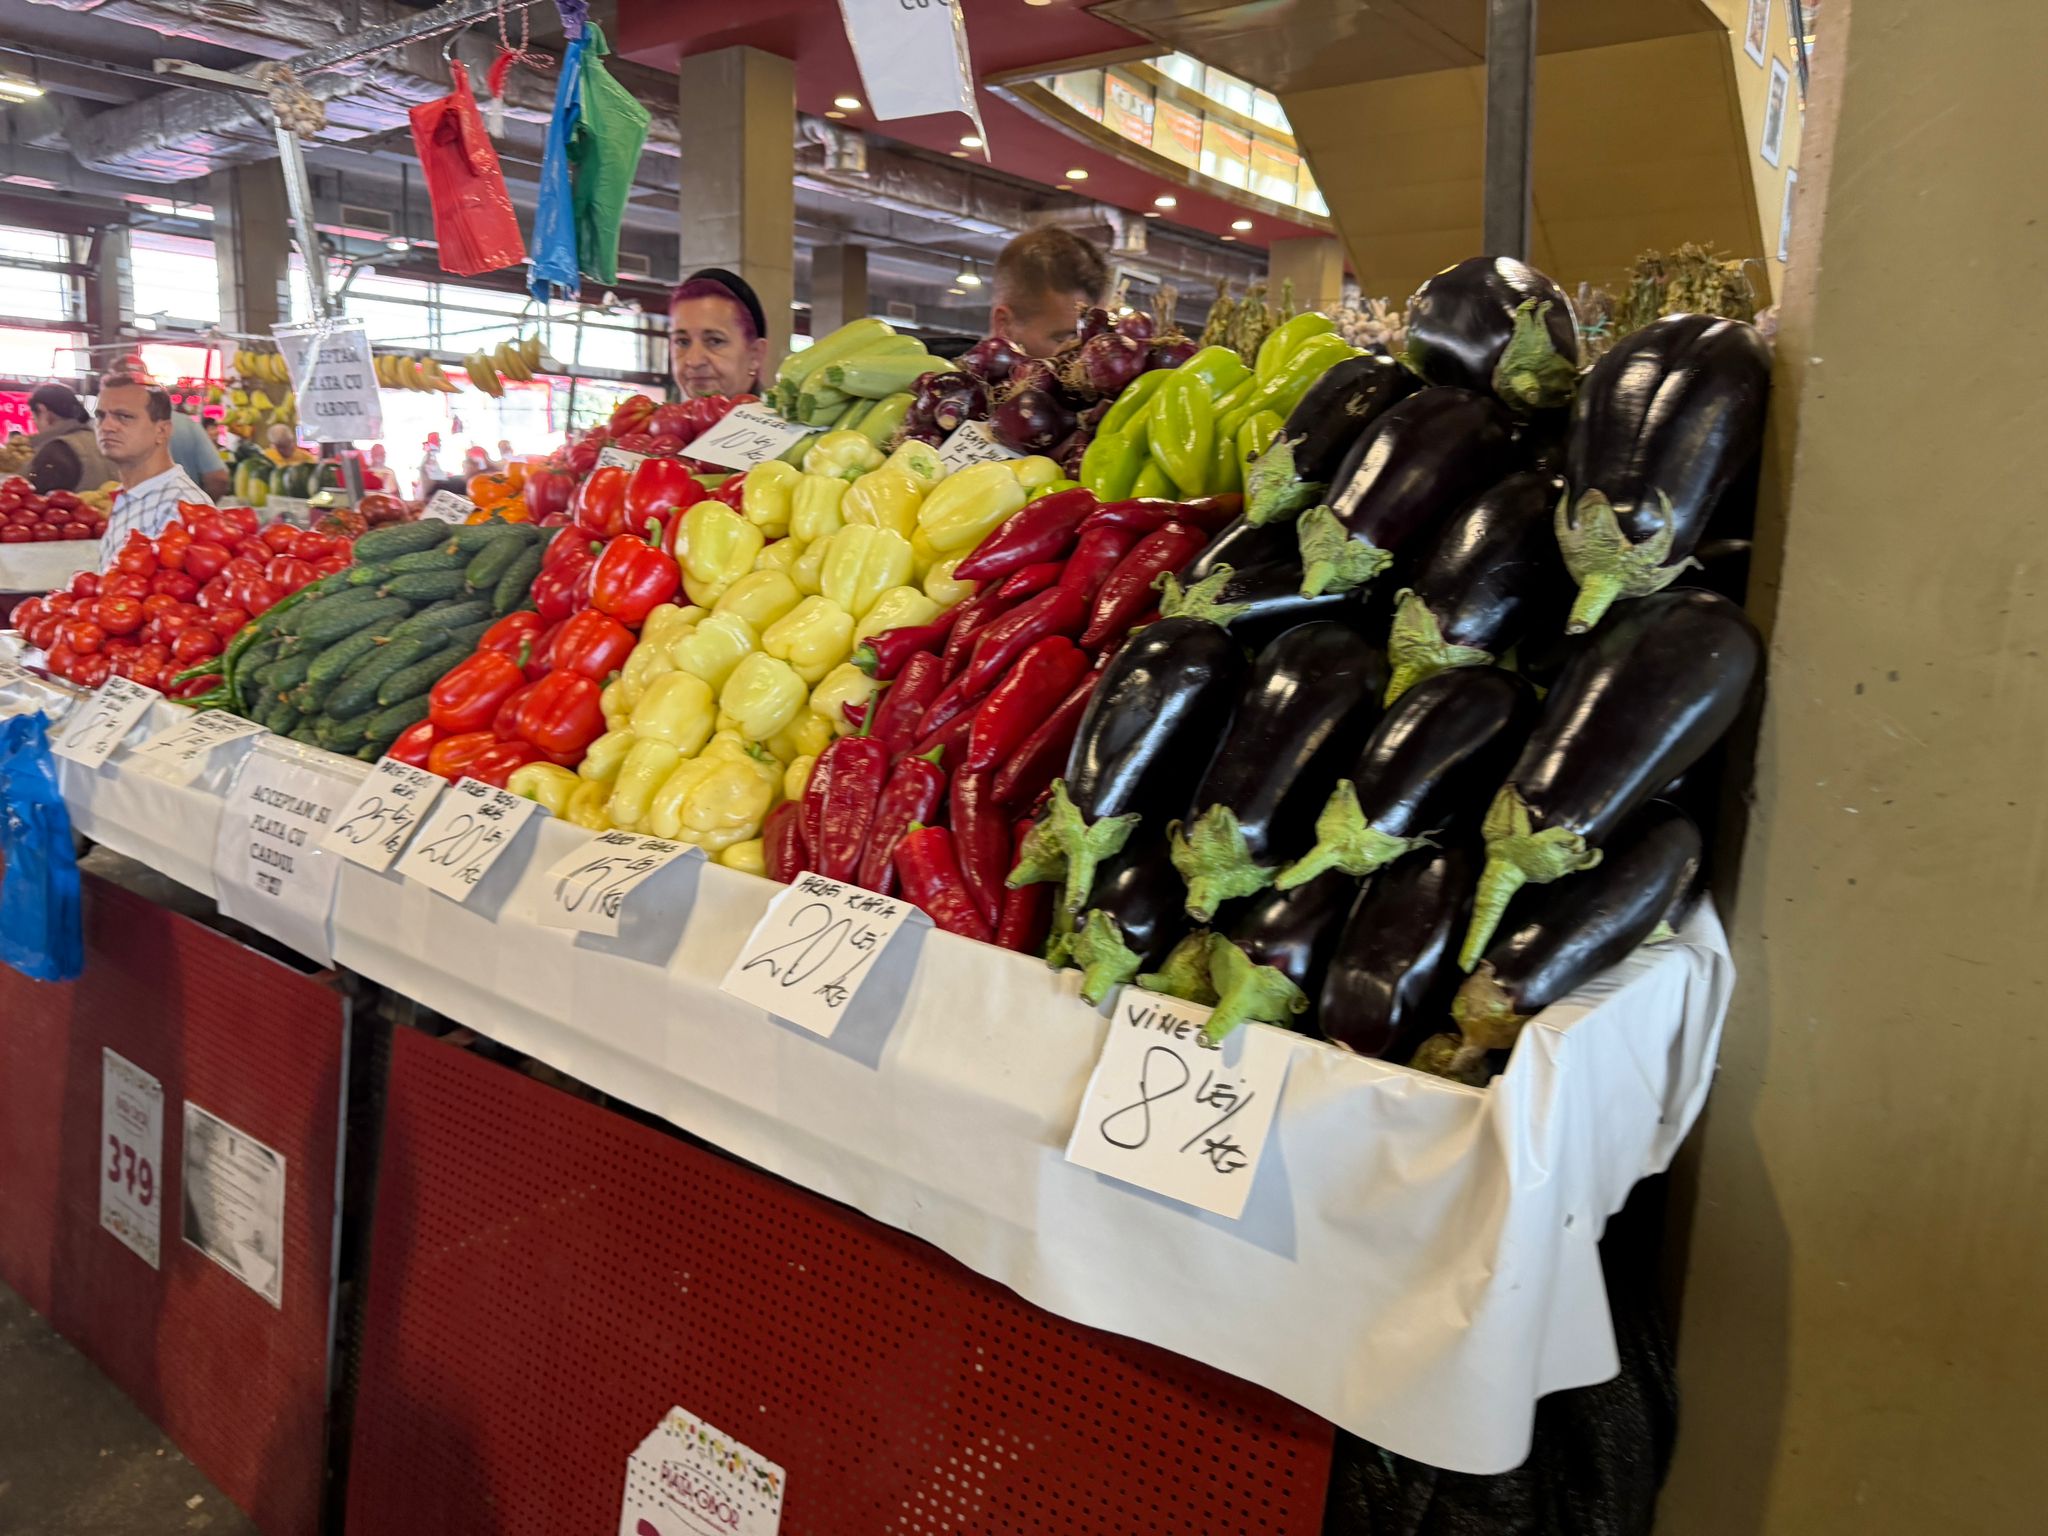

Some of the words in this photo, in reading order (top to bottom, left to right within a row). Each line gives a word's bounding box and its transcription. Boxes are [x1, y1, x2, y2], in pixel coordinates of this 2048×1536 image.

[249, 784, 317, 819] ACCEPTAM
[249, 814, 287, 841] PLATA
[287, 827, 309, 847] CU
[418, 813, 485, 867] 20
[249, 842, 295, 875] CARDUL
[554, 856, 632, 912] 15
[742, 902, 853, 988] 20
[1100, 1045, 1190, 1150] 8
[108, 1134, 153, 1207] 379
